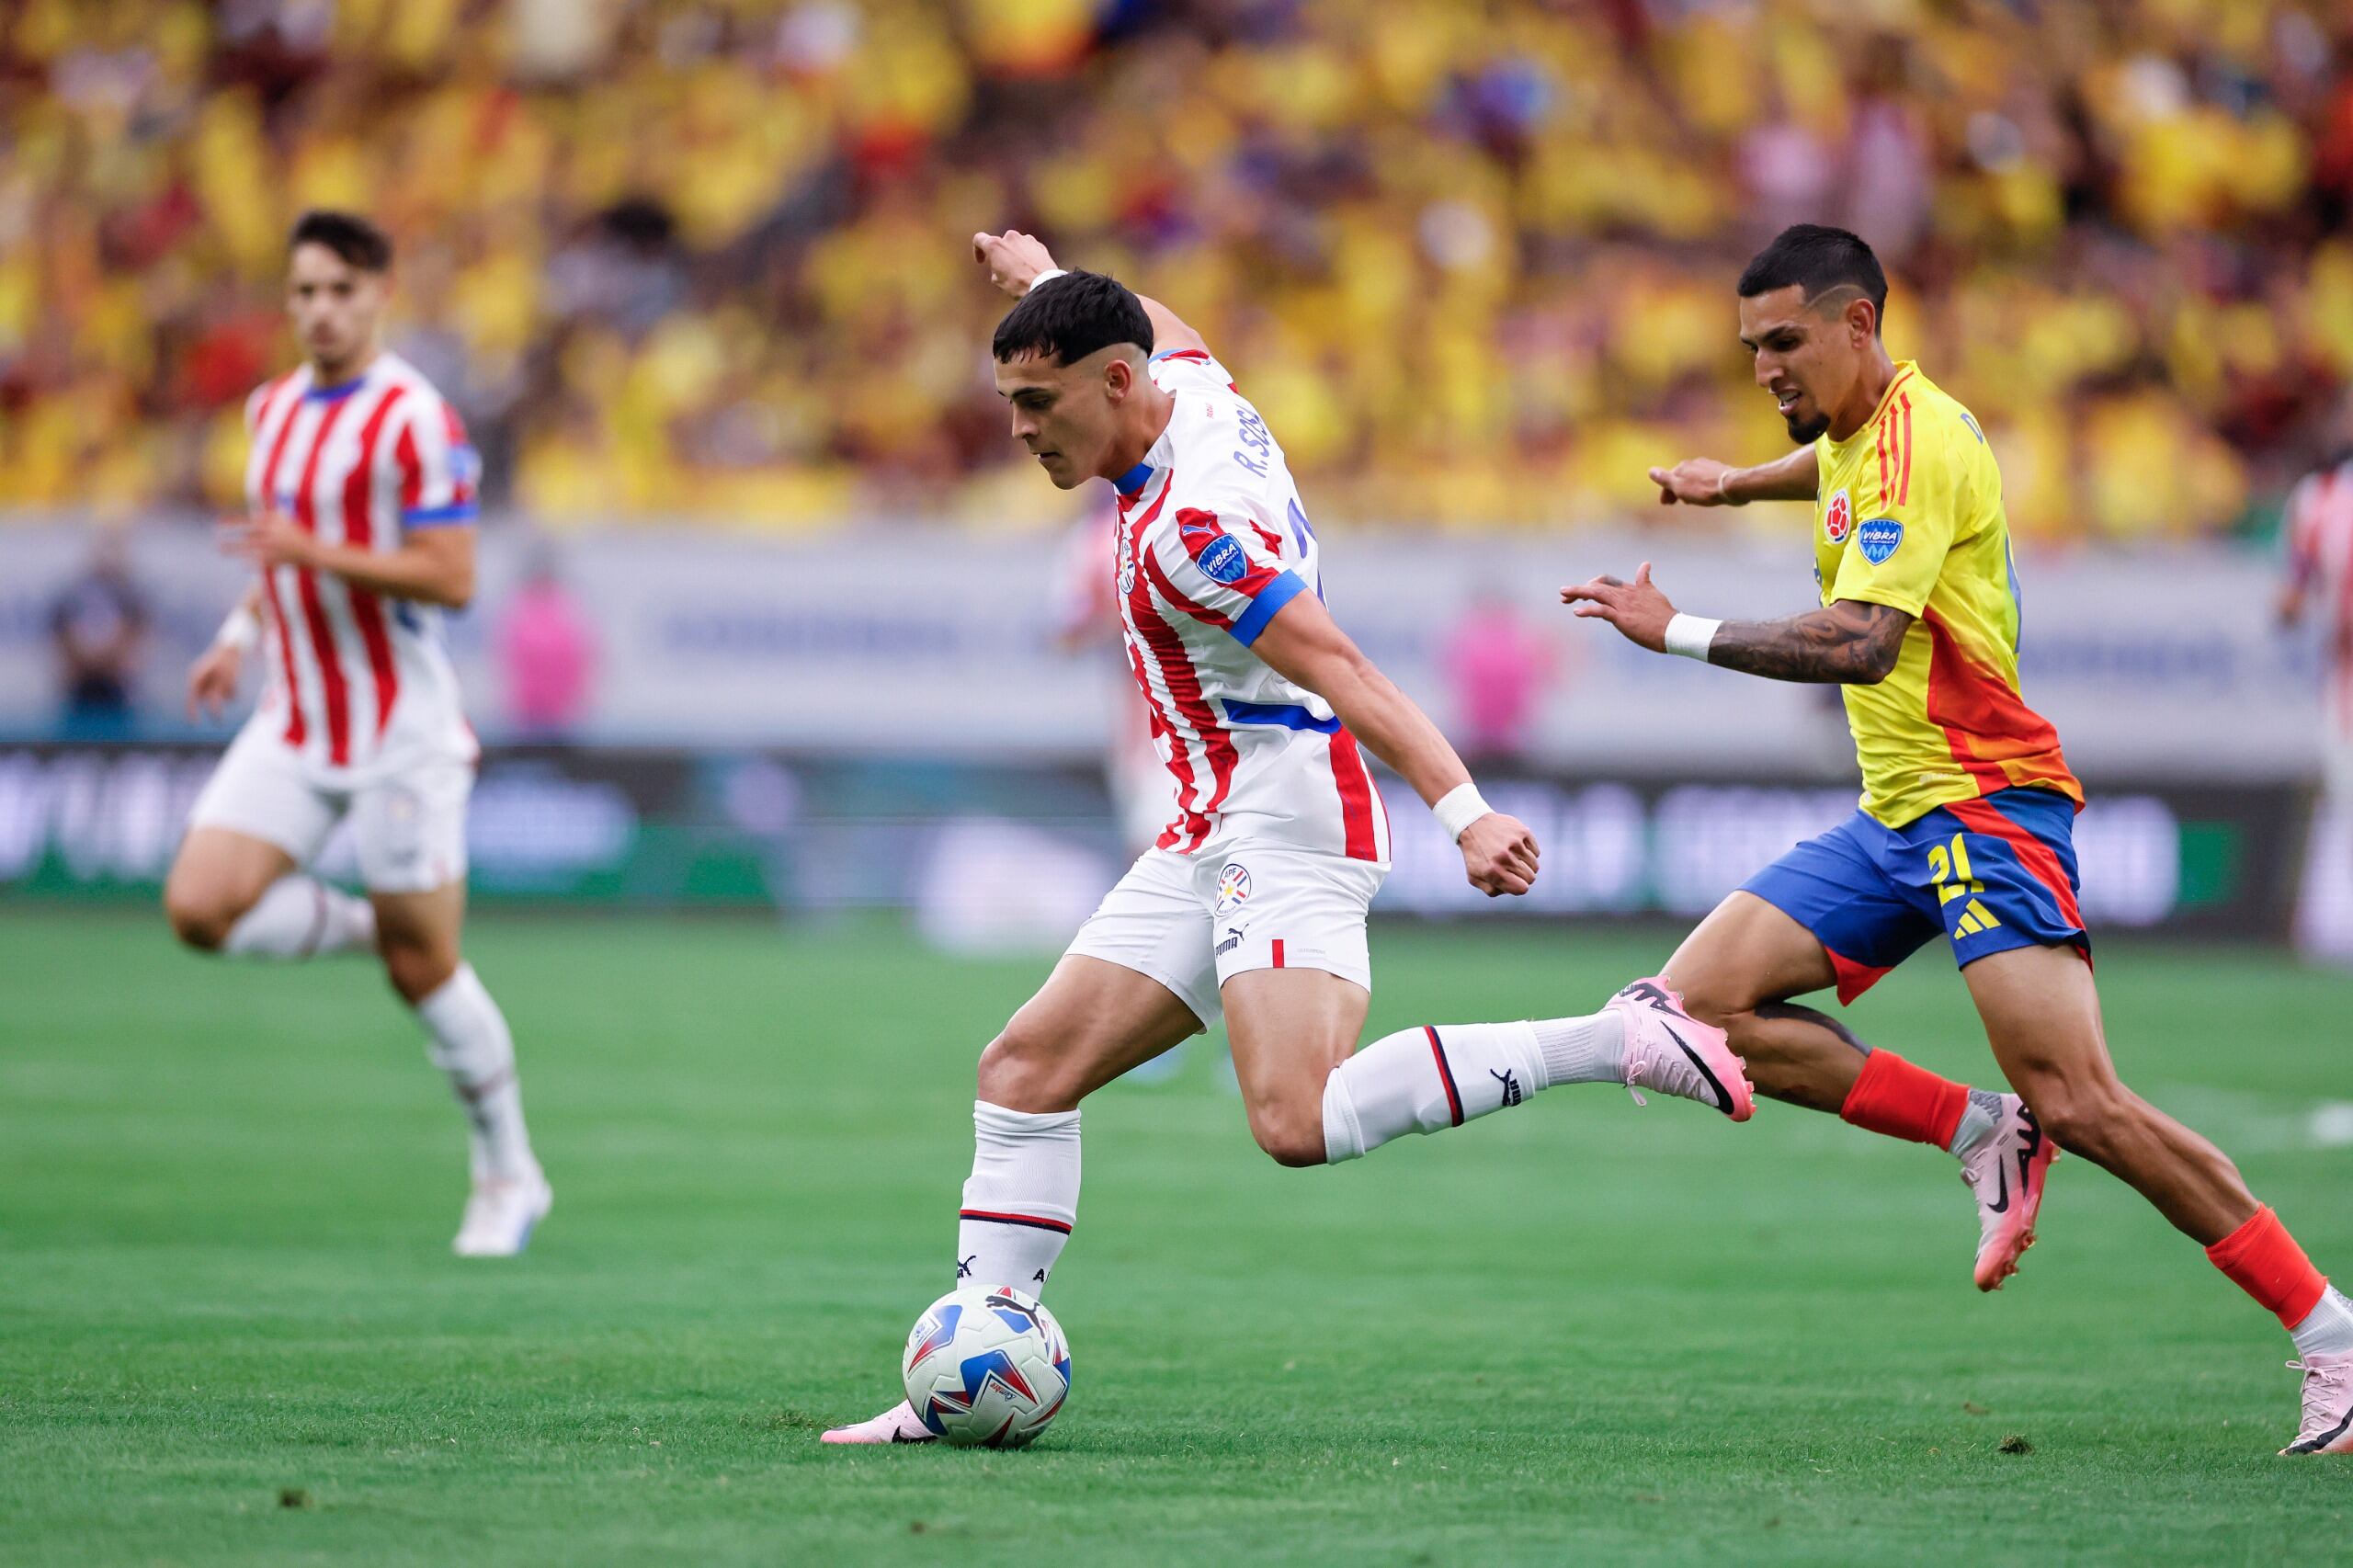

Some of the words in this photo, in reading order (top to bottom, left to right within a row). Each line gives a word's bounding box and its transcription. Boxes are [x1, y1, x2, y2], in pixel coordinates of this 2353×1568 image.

[1233, 450, 1268, 479] R.
[1863, 530, 1898, 540] VIBRA
[1207, 541, 1237, 572] VIBRA
[1224, 867, 1238, 880] APF
[1927, 832, 1985, 908] 21
[1215, 937, 1238, 960] PUMA
